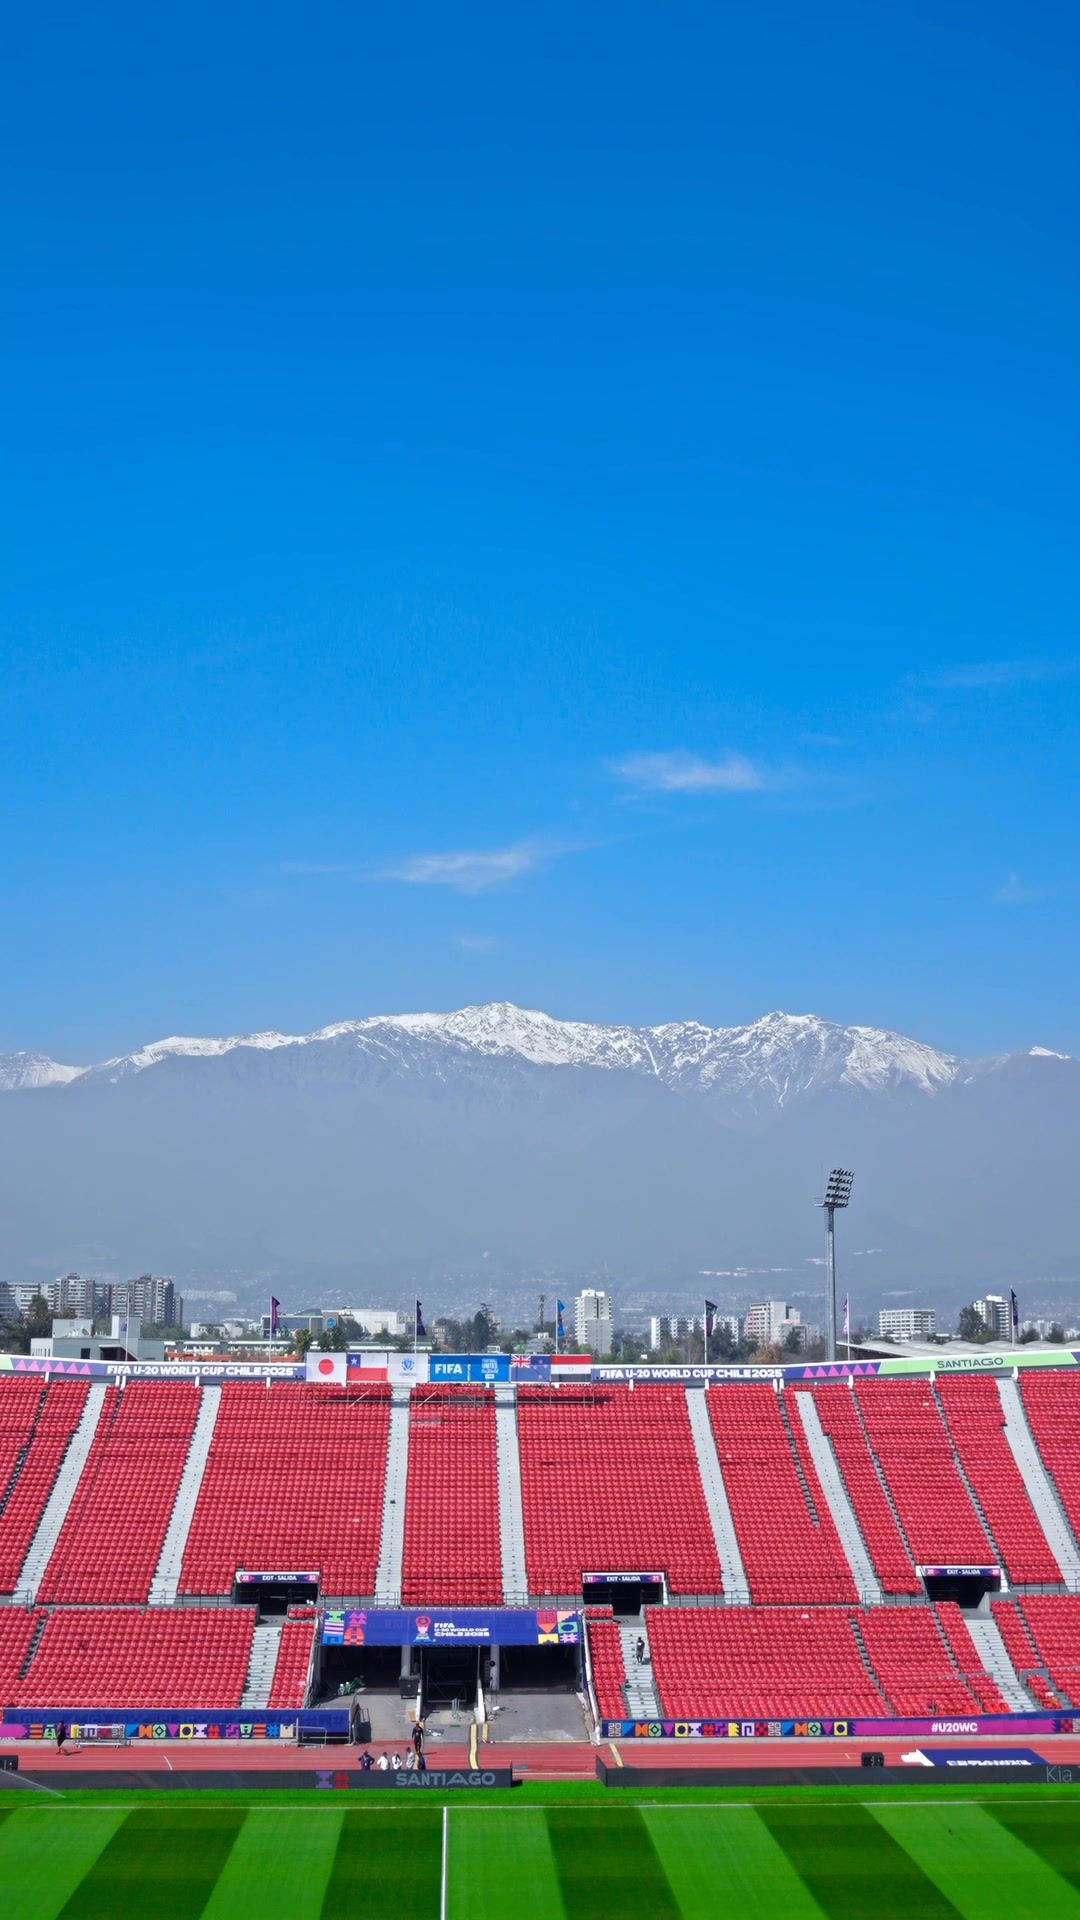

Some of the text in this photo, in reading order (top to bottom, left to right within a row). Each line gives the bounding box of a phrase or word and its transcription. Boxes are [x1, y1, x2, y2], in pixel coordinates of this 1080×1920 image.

[435, 1363, 462, 1375] FIFA
[937, 1357, 1004, 1369] SANTIAGO
[107, 1365, 131, 1376] FIFA
[133, 1366, 159, 1376] U-20
[160, 1367, 200, 1376] WORLD
[202, 1367, 225, 1376] CUP
[226, 1367, 261, 1376] CHILE
[600, 1368, 623, 1379] FIFA
[626, 1368, 650, 1378] U-20
[652, 1368, 691, 1378] WORLD
[693, 1368, 715, 1378] CUP
[716, 1368, 750, 1378] CHILE
[931, 1722, 978, 1732] #U20WC
[396, 1773, 496, 1786] SANTIAGO
[1046, 1766, 1072, 1783] Kia
